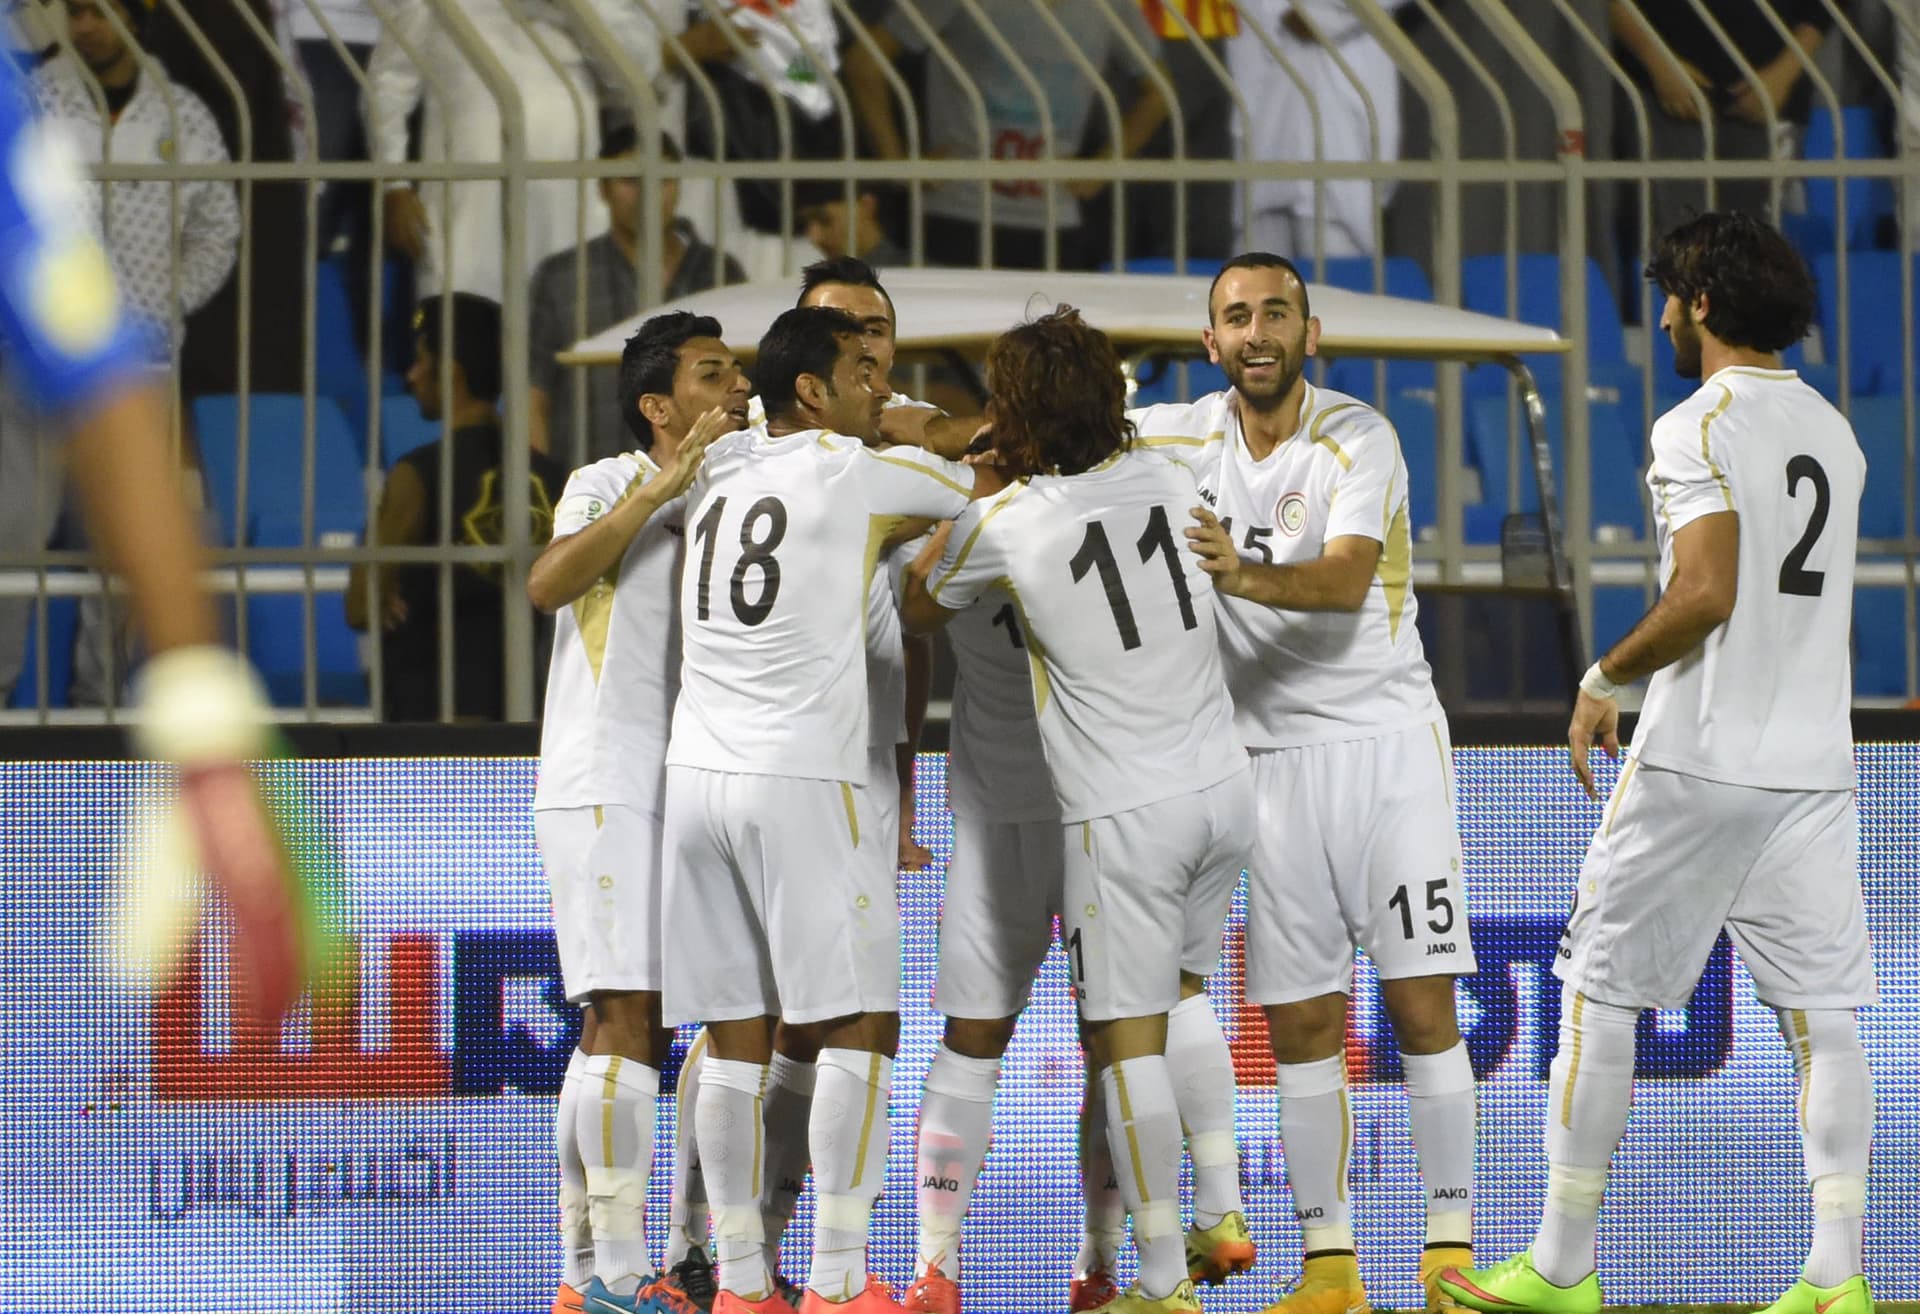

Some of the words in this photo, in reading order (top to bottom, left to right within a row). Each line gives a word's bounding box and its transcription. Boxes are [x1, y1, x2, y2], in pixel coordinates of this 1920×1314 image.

[1778, 454, 1831, 596] 2
[694, 495, 788, 627] 18
[1069, 505, 1198, 651] 11
[1388, 878, 1454, 939] 15
[1425, 942, 1457, 956] JAKO
[922, 1175, 959, 1193] JAKO
[1432, 1187, 1468, 1200] JAKO
[1296, 1206, 1324, 1221] AKO
